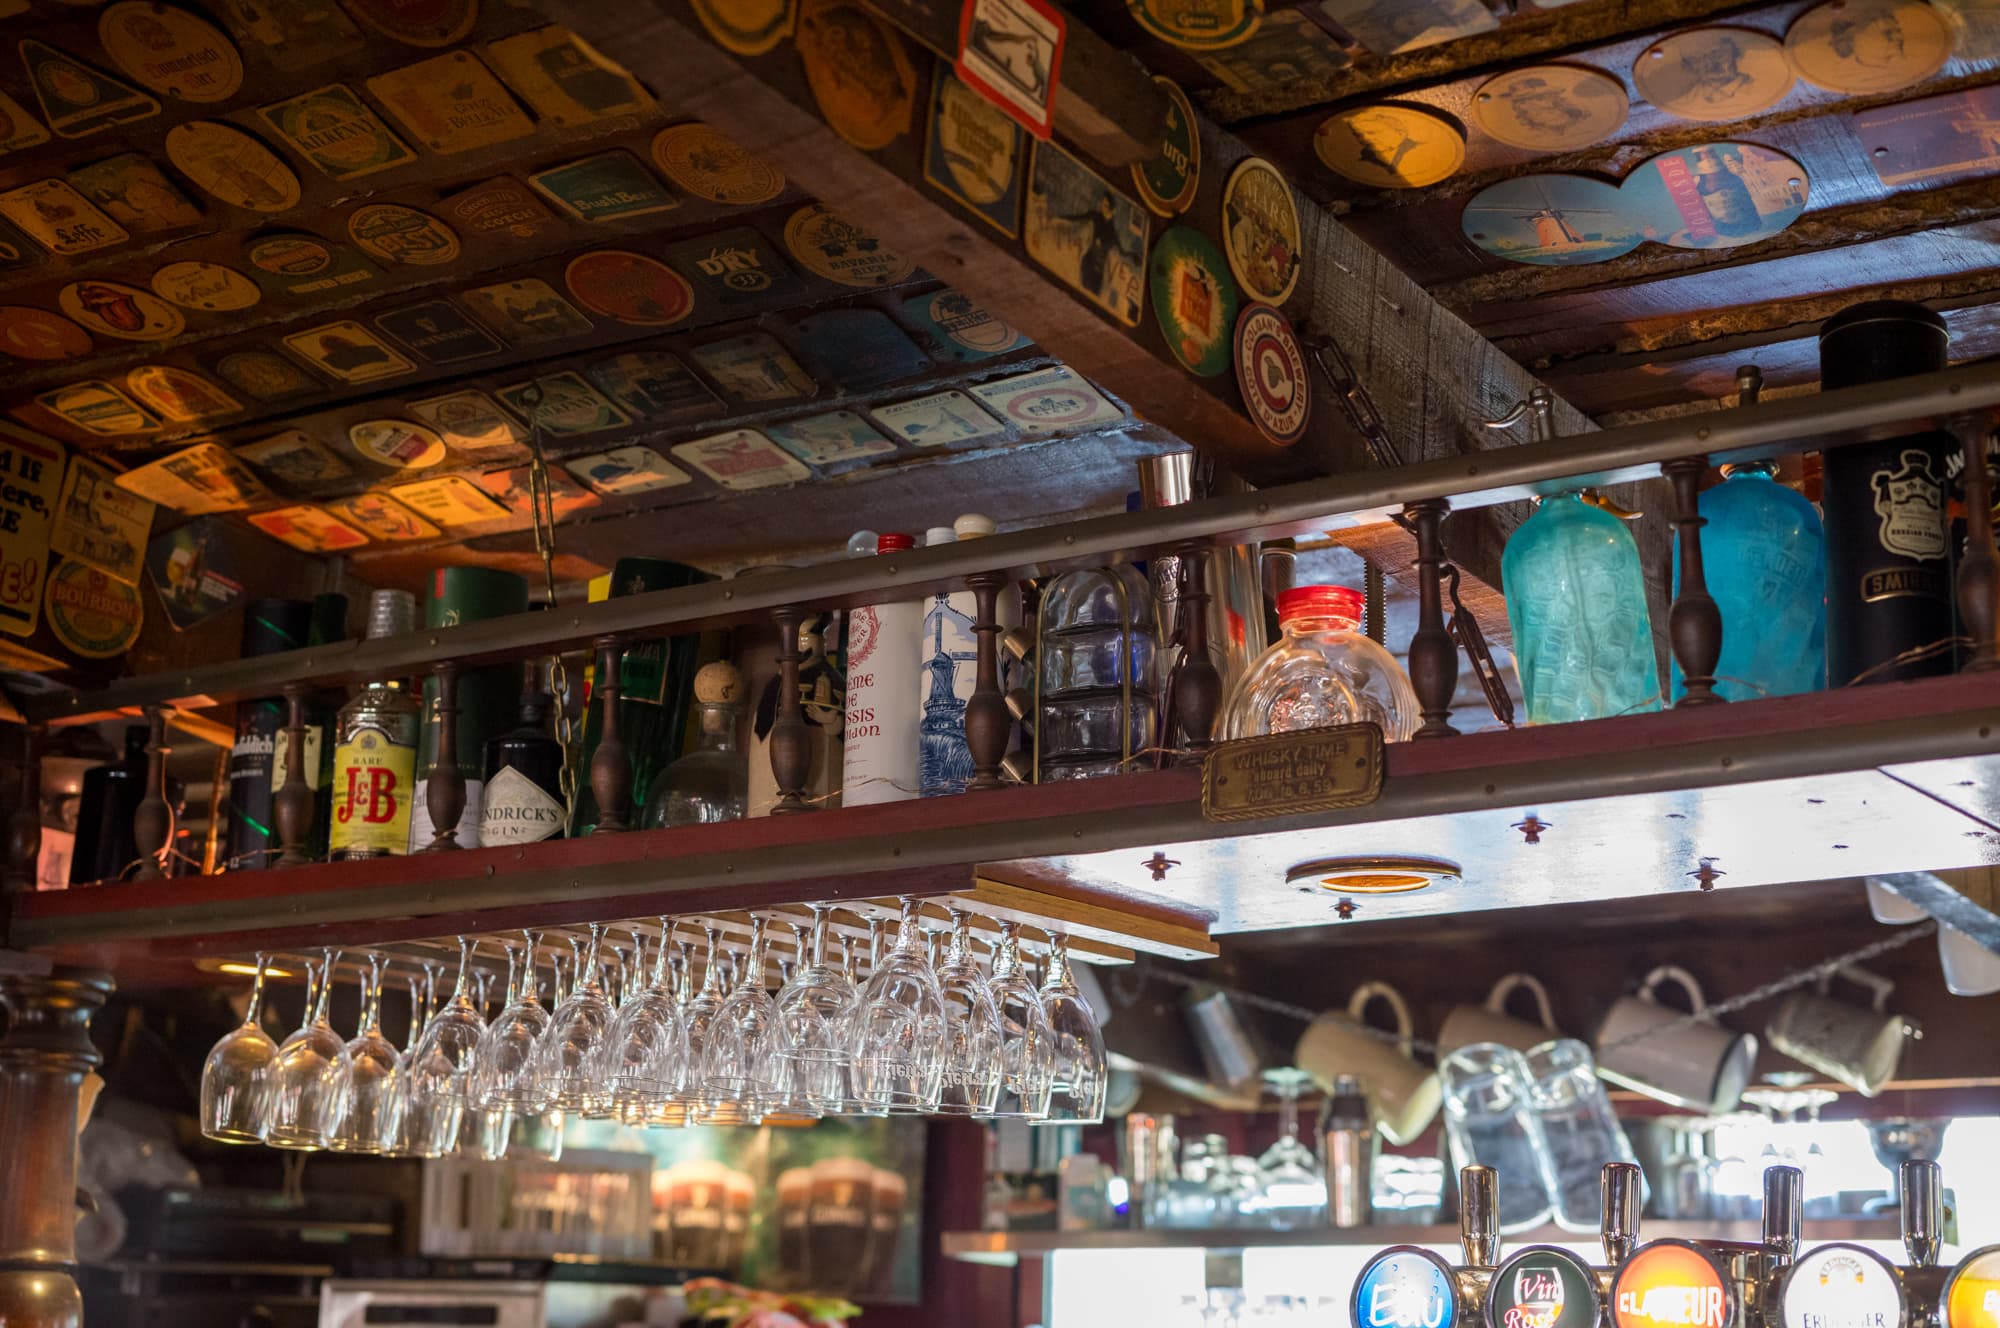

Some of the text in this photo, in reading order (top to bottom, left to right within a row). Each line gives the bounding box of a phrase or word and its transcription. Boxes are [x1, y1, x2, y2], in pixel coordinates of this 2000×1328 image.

[295, 116, 376, 151] KILKENNY
[55, 223, 105, 245] Leffe
[373, 226, 450, 251] BEST
[696, 249, 762, 277] DRY
[829, 252, 899, 271] BAVARIA
[1282, 336, 1305, 416] BREWERY
[1263, 409, 1297, 432] D'AZUR
[0, 555, 39, 606] E!
[55, 582, 139, 622] BOURBON
[353, 756, 384, 766] RARE
[1235, 741, 1347, 770] WHISKY TIME
[1253, 761, 1327, 783] aboard daily
[337, 766, 397, 824] J&B
[481, 805, 559, 824] NDRICK'S
[492, 826, 520, 836] GIN
[1520, 1273, 1561, 1301] Vin
